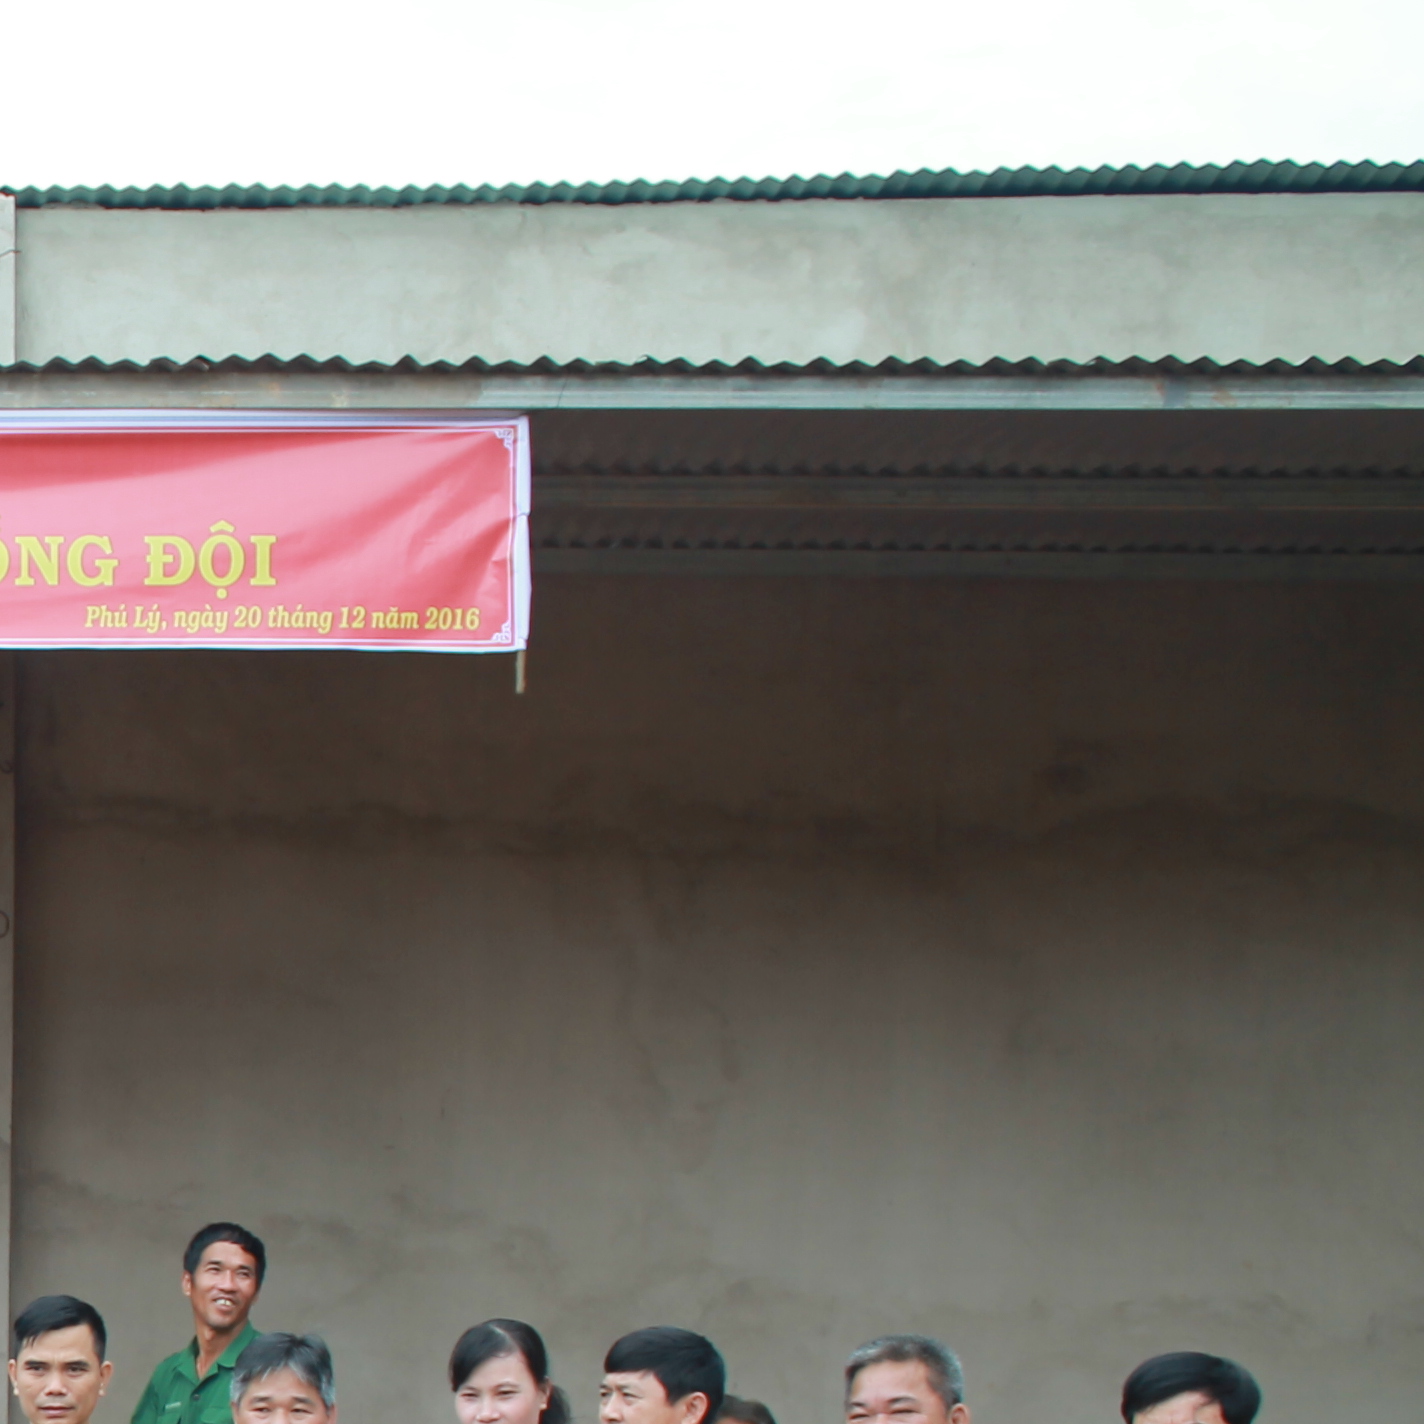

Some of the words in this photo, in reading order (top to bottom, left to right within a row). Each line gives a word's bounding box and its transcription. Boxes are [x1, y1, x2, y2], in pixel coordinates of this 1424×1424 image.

[143, 520, 278, 599] ĐỘI
[84, 605, 128, 630] Phú
[173, 609, 229, 635] ngày
[233, 605, 263, 629] 20
[267, 605, 334, 636] tháng
[338, 605, 367, 630] 12
[371, 606, 421, 631] năm
[423, 606, 481, 632] 2016
